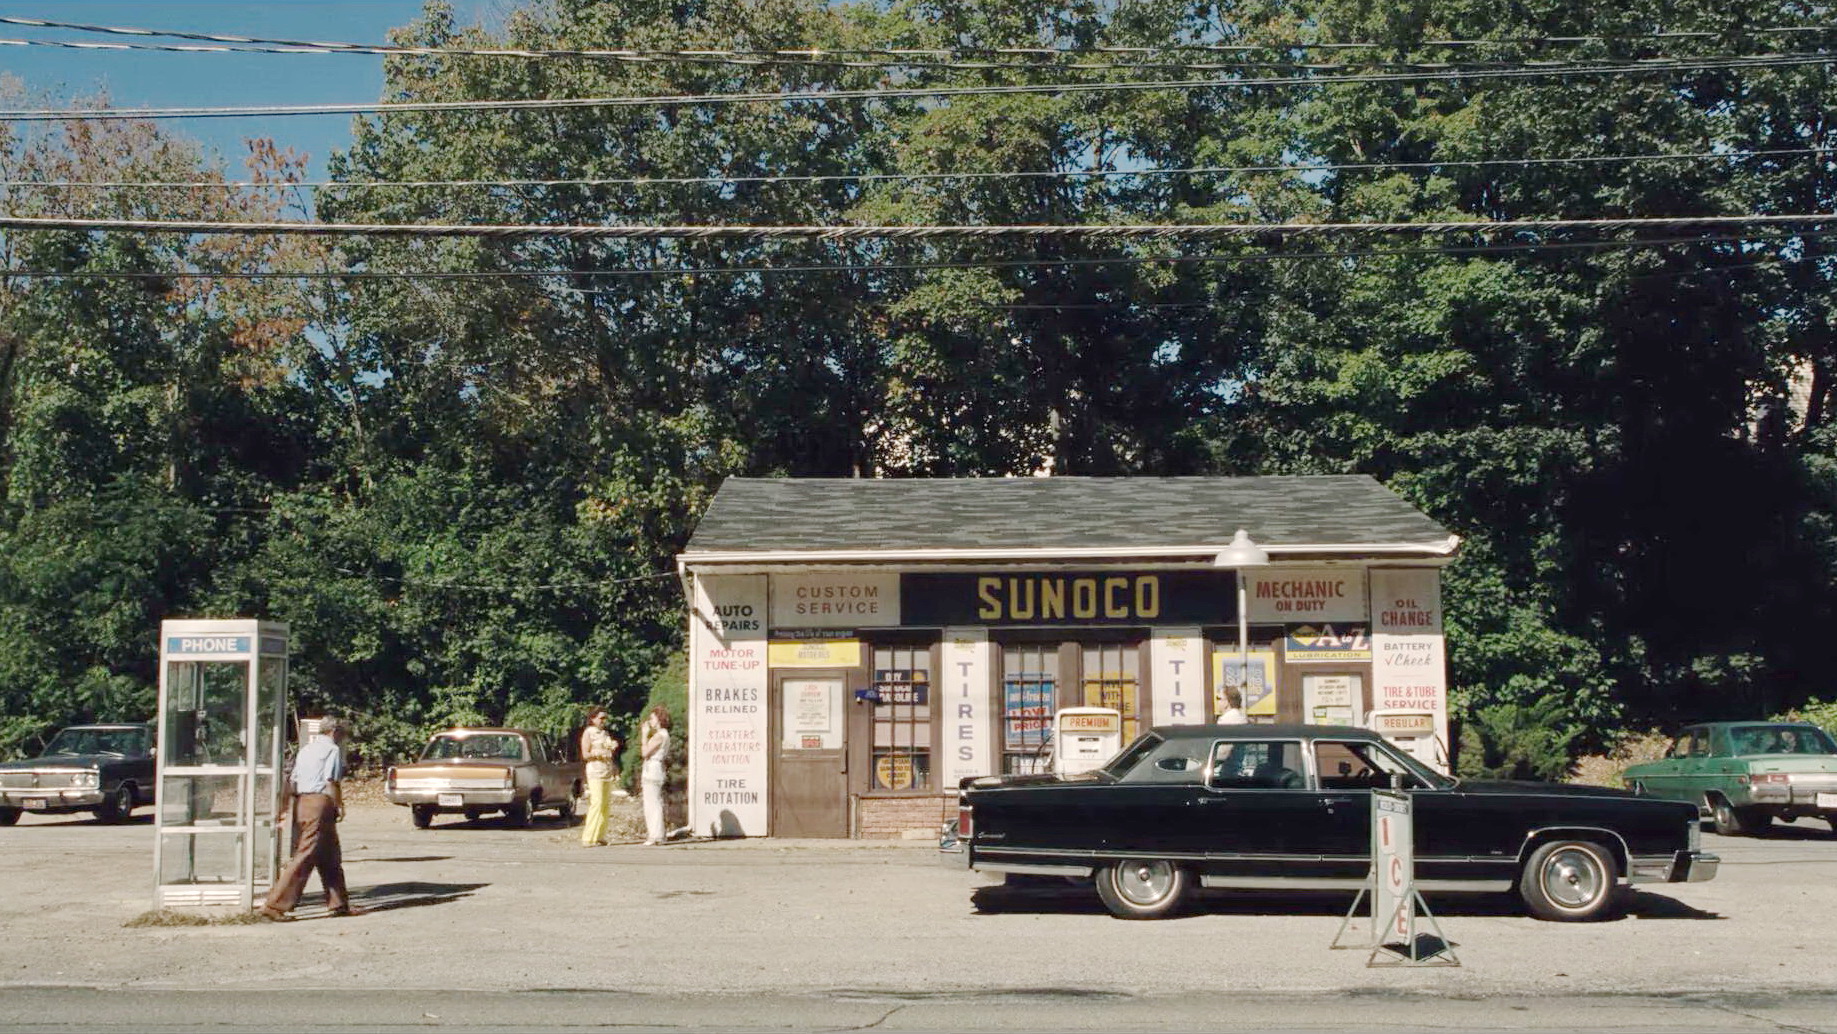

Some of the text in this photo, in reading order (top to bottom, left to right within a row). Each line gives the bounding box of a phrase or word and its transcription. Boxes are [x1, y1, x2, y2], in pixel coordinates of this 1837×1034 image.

[796, 585, 878, 598] CUSTOM
[1256, 580, 1345, 598] MECHANIC
[978, 577, 1159, 619] SUNOCO
[796, 601, 878, 614] SERVICE
[1275, 600, 1326, 612] ON DUTY
[1395, 600, 1418, 608] OIL
[713, 605, 753, 617] AUTO
[1381, 610, 1433, 626] CHANGE
[705, 620, 759, 631] REPAIRS
[1316, 624, 1342, 647] A
[1351, 627, 1369, 651] Z
[182, 638, 237, 652] PHONE
[709, 648, 755, 658] MOTOR
[1293, 651, 1361, 659] LUBRICATION
[1394, 653, 1431, 666] Check
[704, 661, 760, 670] TUNE-UP
[705, 688, 758, 701] BRAKES
[1168, 660, 1186, 726] TIR
[1383, 686, 1437, 697] TIRE & TUBE
[705, 705, 758, 713] RELINED
[1384, 700, 1437, 710] SERVICE
[957, 662, 973, 760] TIRES
[1070, 717, 1110, 728] PREMIUM
[1384, 718, 1426, 728] REGULAR
[709, 730, 755, 739] STARTERS
[702, 742, 761, 752] GENERATORS
[711, 754, 751, 764] IGNITION
[717, 779, 746, 788] TIRE
[704, 792, 758, 804] ROTATION
